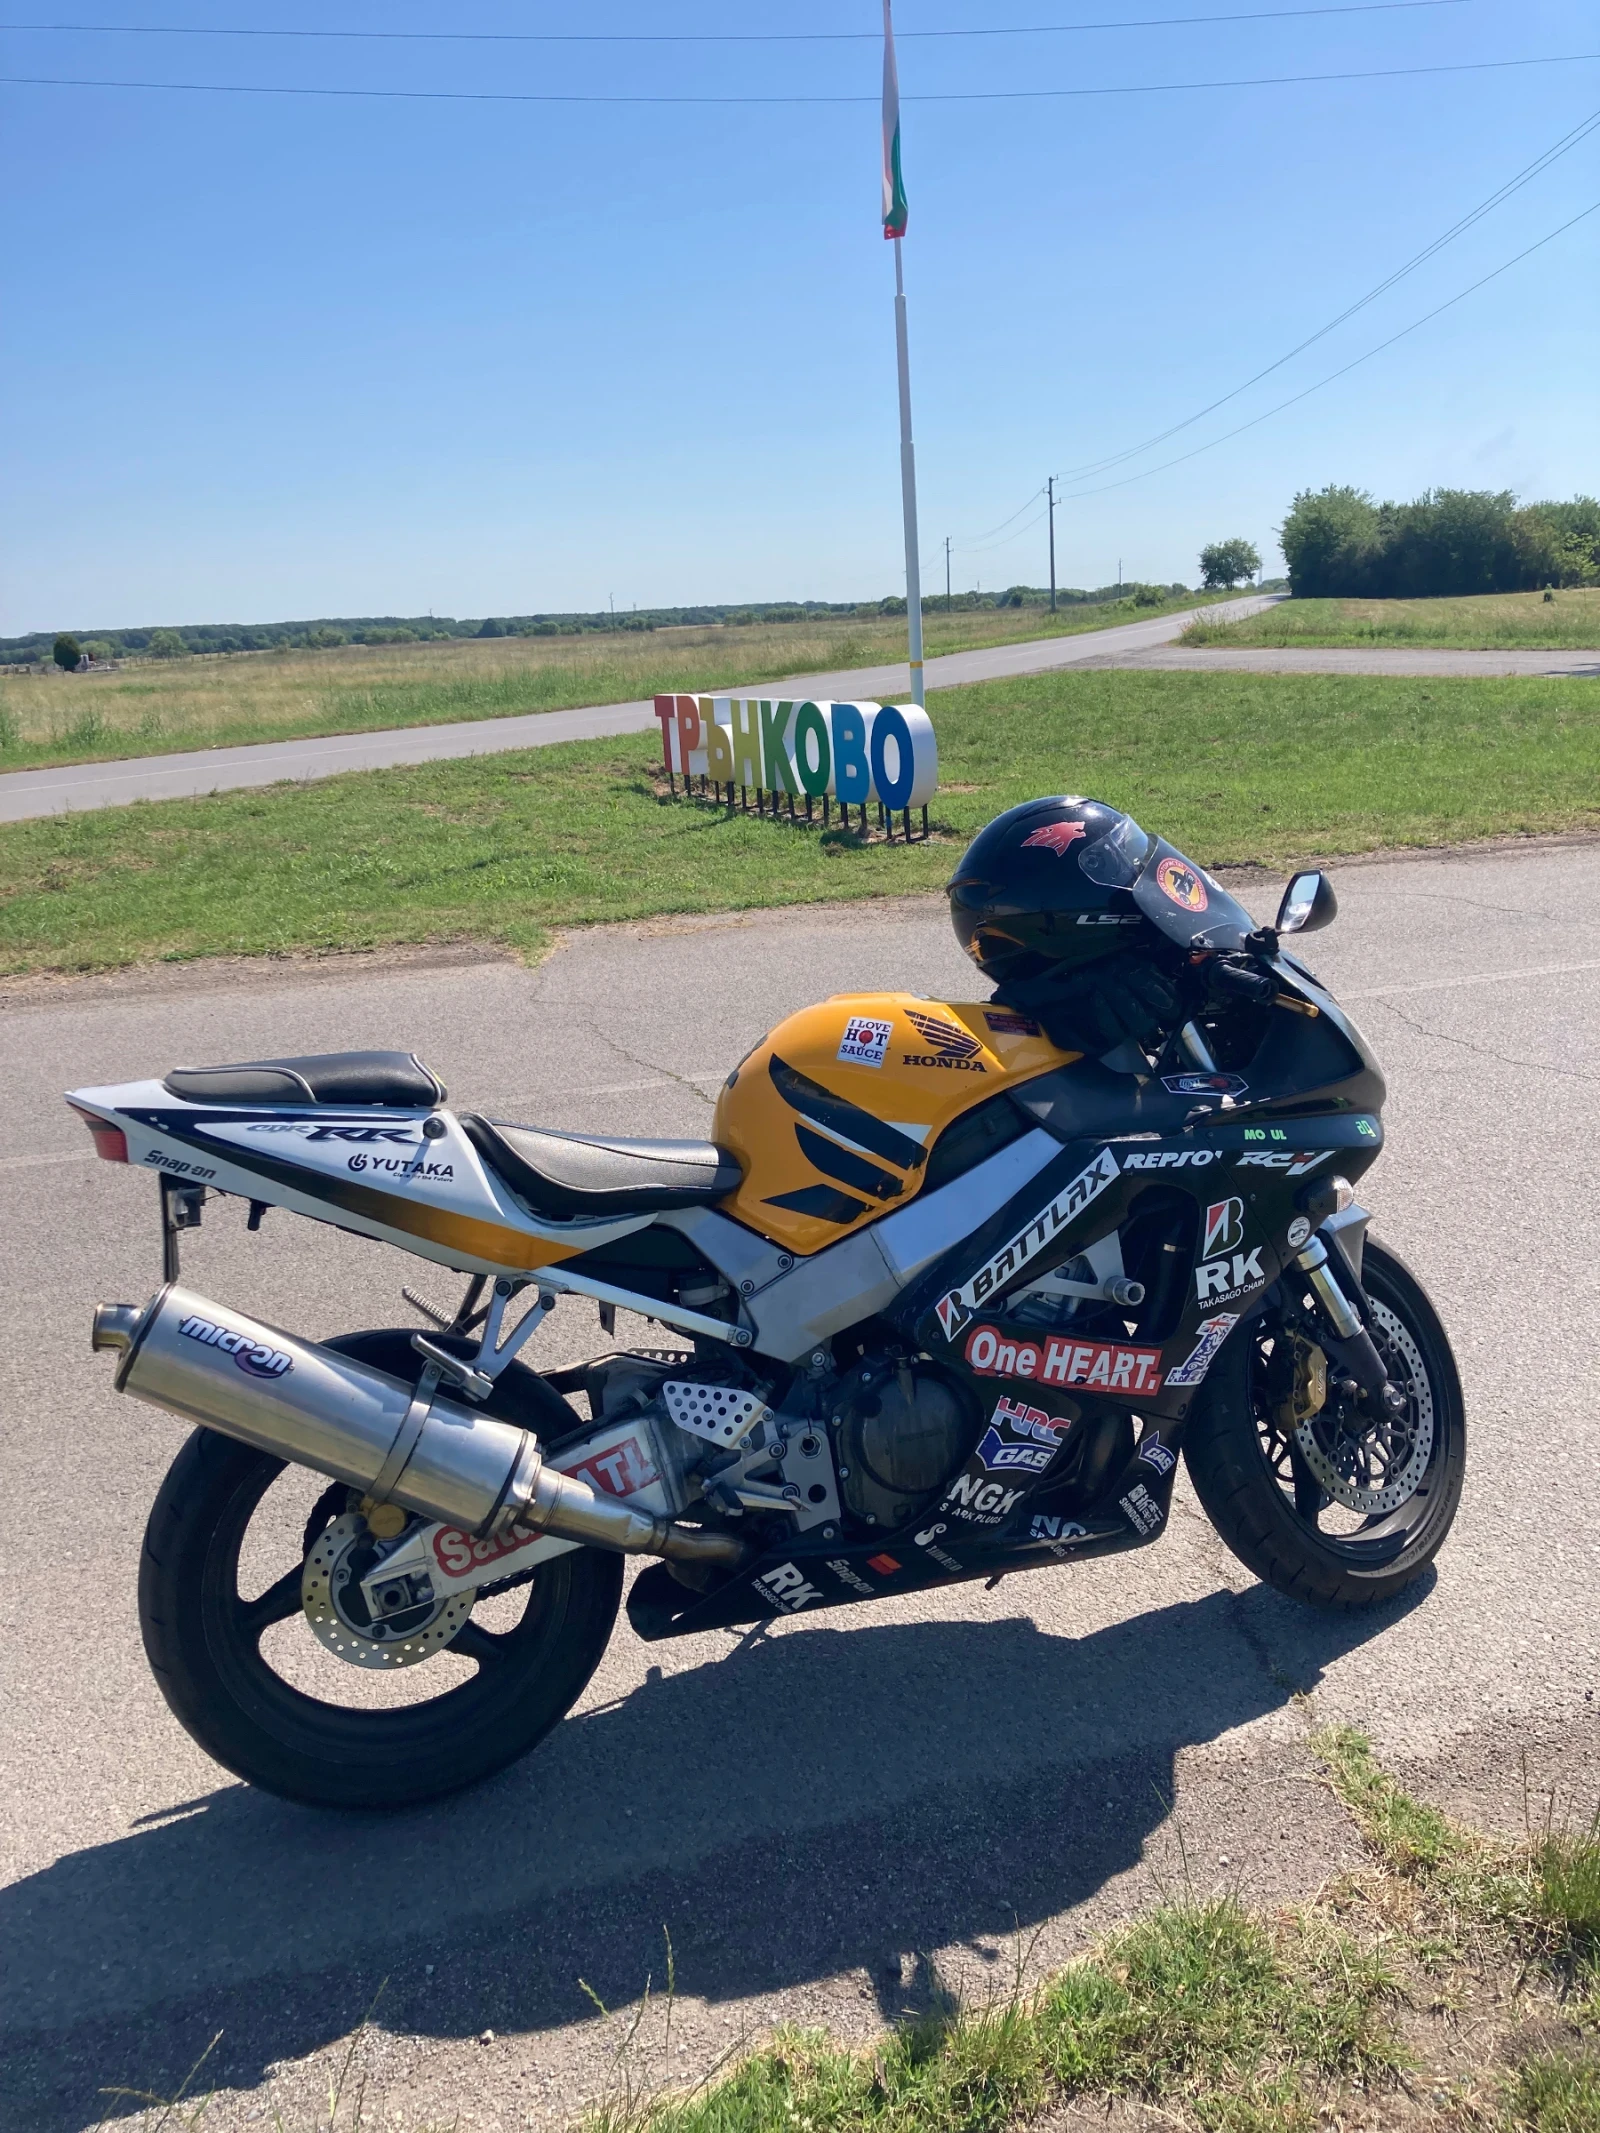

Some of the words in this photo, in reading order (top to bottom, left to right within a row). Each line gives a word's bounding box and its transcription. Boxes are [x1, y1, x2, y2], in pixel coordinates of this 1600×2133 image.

[654, 694, 928, 811] ТРЪНКОВО
[1076, 914, 1143, 925] LS2
[850, 1019, 857, 1027] I
[858, 1020, 891, 1033] LOVE
[840, 1044, 883, 1061] SAUCE
[903, 1054, 987, 1073] HONDA
[372, 1157, 454, 1177] YUTAKA
[973, 1161, 1110, 1304] BATTLAX
[1195, 1246, 1265, 1300] RK
[1198, 1288, 1241, 1310] TAKASAGO
[1242, 1278, 1266, 1294] CHAIN
[178, 1315, 293, 1374] micron
[970, 1330, 1037, 1377] One
[990, 1395, 1072, 1446] HRC
[992, 1448, 1051, 1467] GAS
[1144, 1447, 1173, 1470] GAS
[946, 1473, 1026, 1515] NGK
[939, 1502, 975, 1521] SARK
[973, 1513, 1004, 1524] PLUGS
[1118, 1497, 1150, 1536] SHINDENGEN
[761, 1561, 825, 1610] RK
